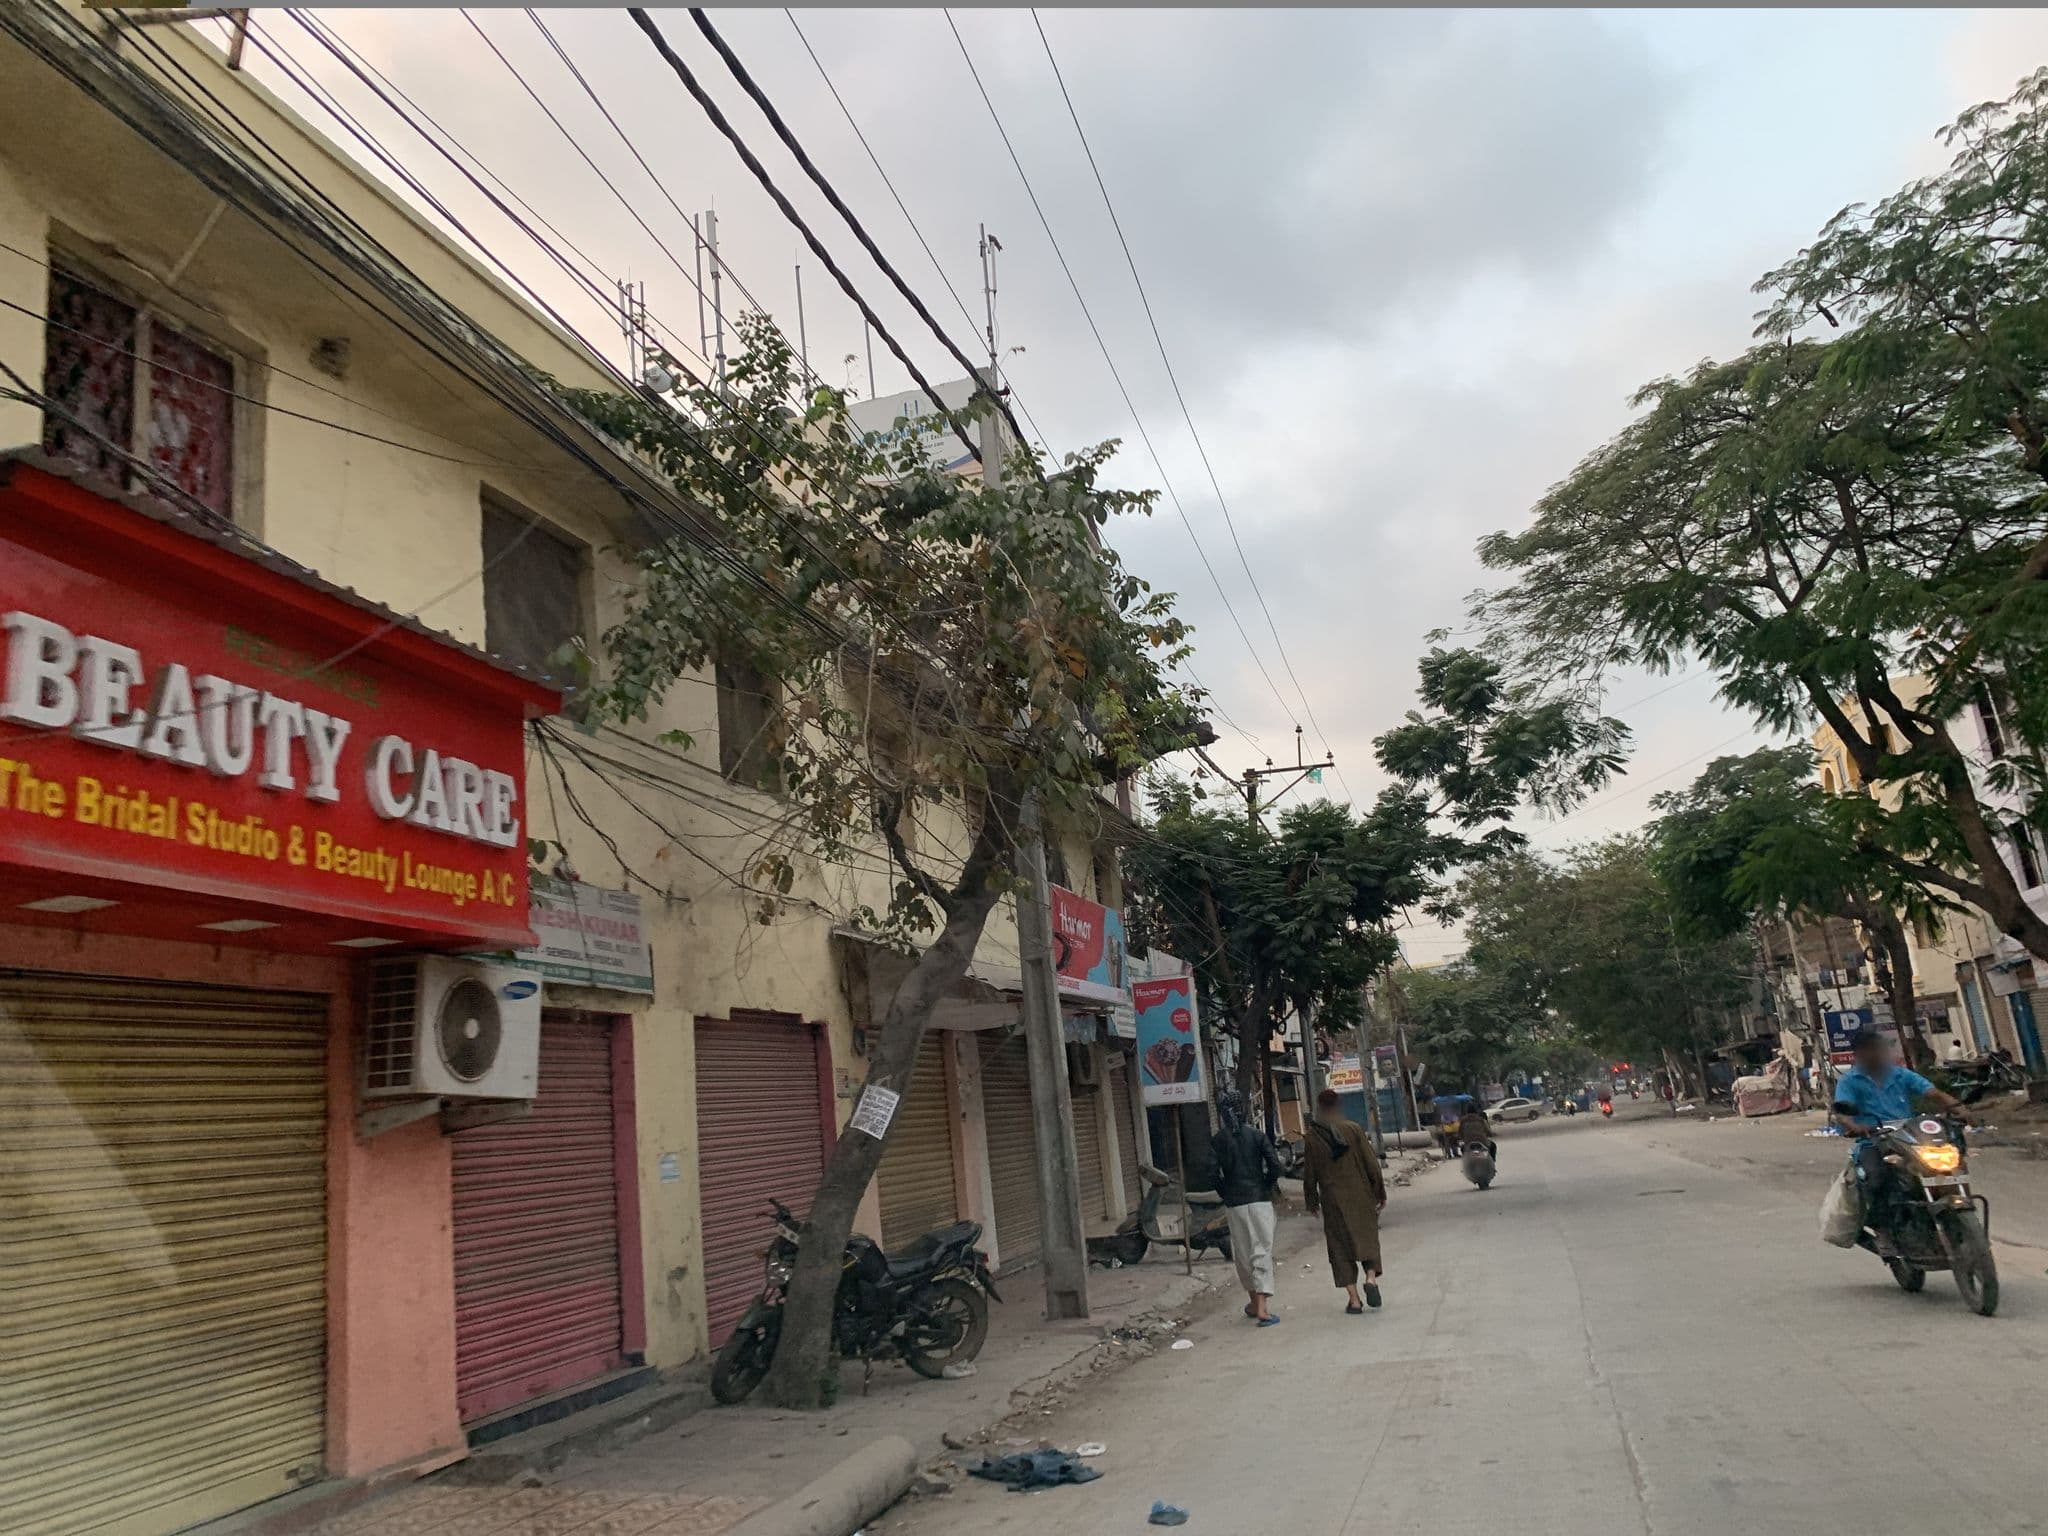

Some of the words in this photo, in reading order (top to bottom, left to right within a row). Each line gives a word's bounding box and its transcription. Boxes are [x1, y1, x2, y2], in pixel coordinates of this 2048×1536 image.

[0, 611, 352, 802] BEAUTY
[366, 735, 520, 849] CARE
[0, 758, 67, 819] The
[75, 776, 178, 840] Bridal
[186, 802, 280, 860] Studio
[287, 825, 307, 866] &
[315, 830, 398, 894] Beauty
[403, 850, 478, 906] Lounge
